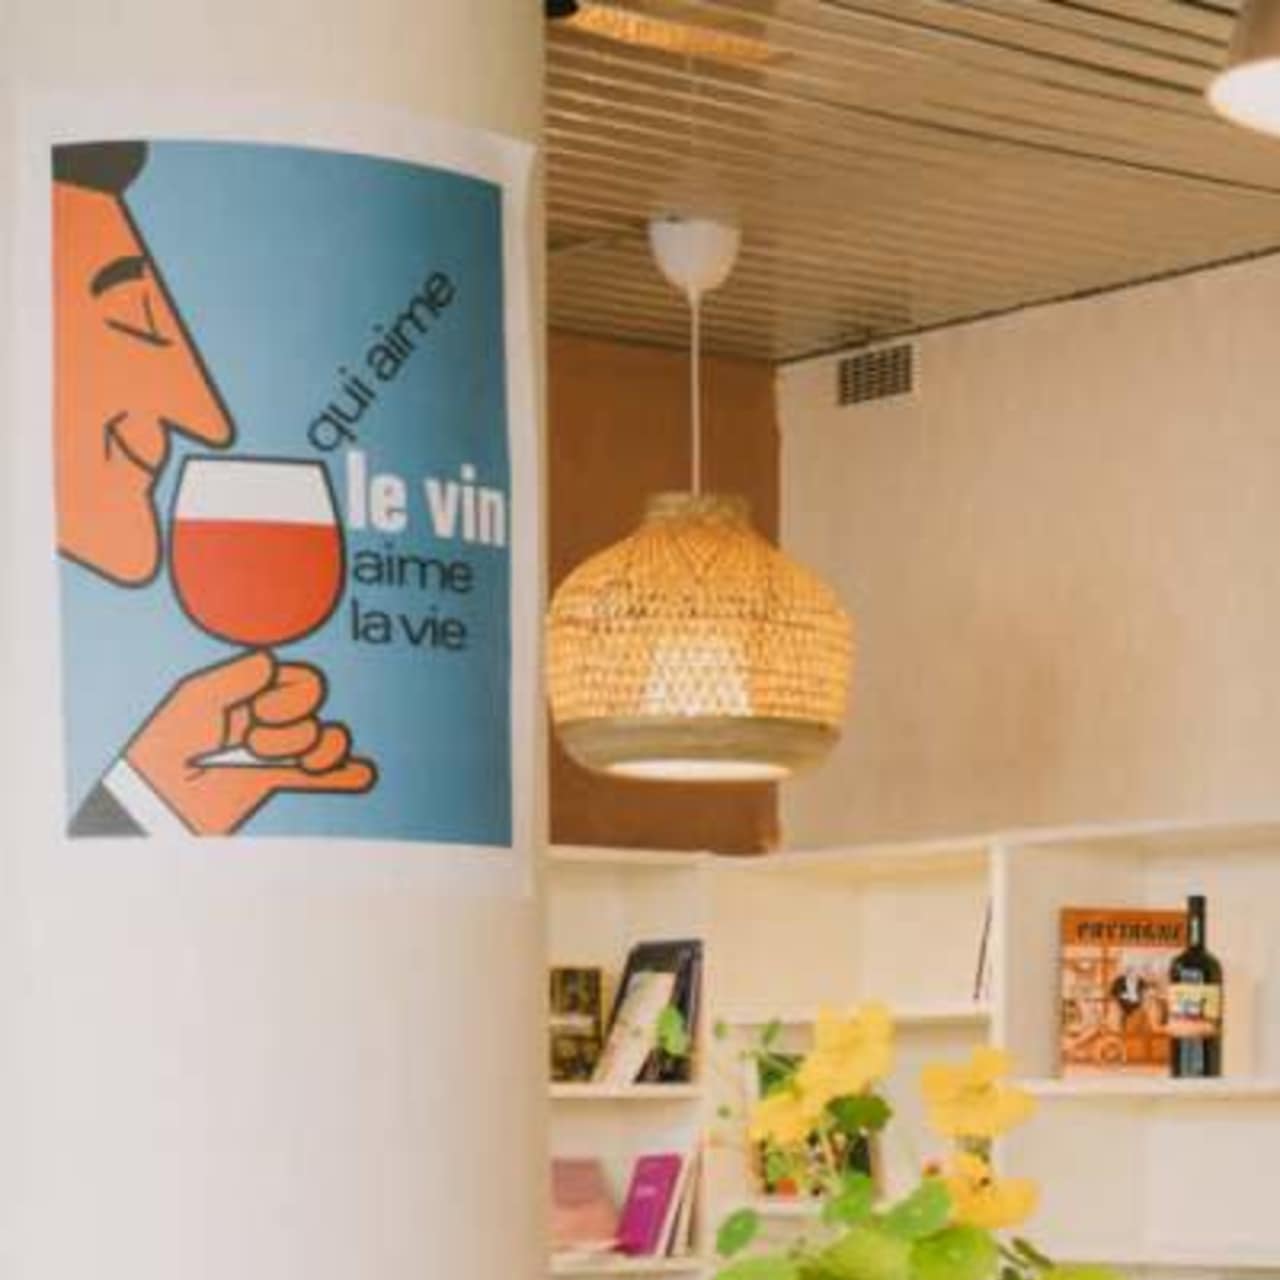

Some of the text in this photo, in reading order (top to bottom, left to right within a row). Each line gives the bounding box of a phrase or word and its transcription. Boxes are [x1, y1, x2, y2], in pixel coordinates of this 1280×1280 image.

[306, 271, 455, 452] qui aime
[345, 448, 506, 548] le vin
[351, 544, 474, 594] aime
[350, 597, 467, 652] la vie
